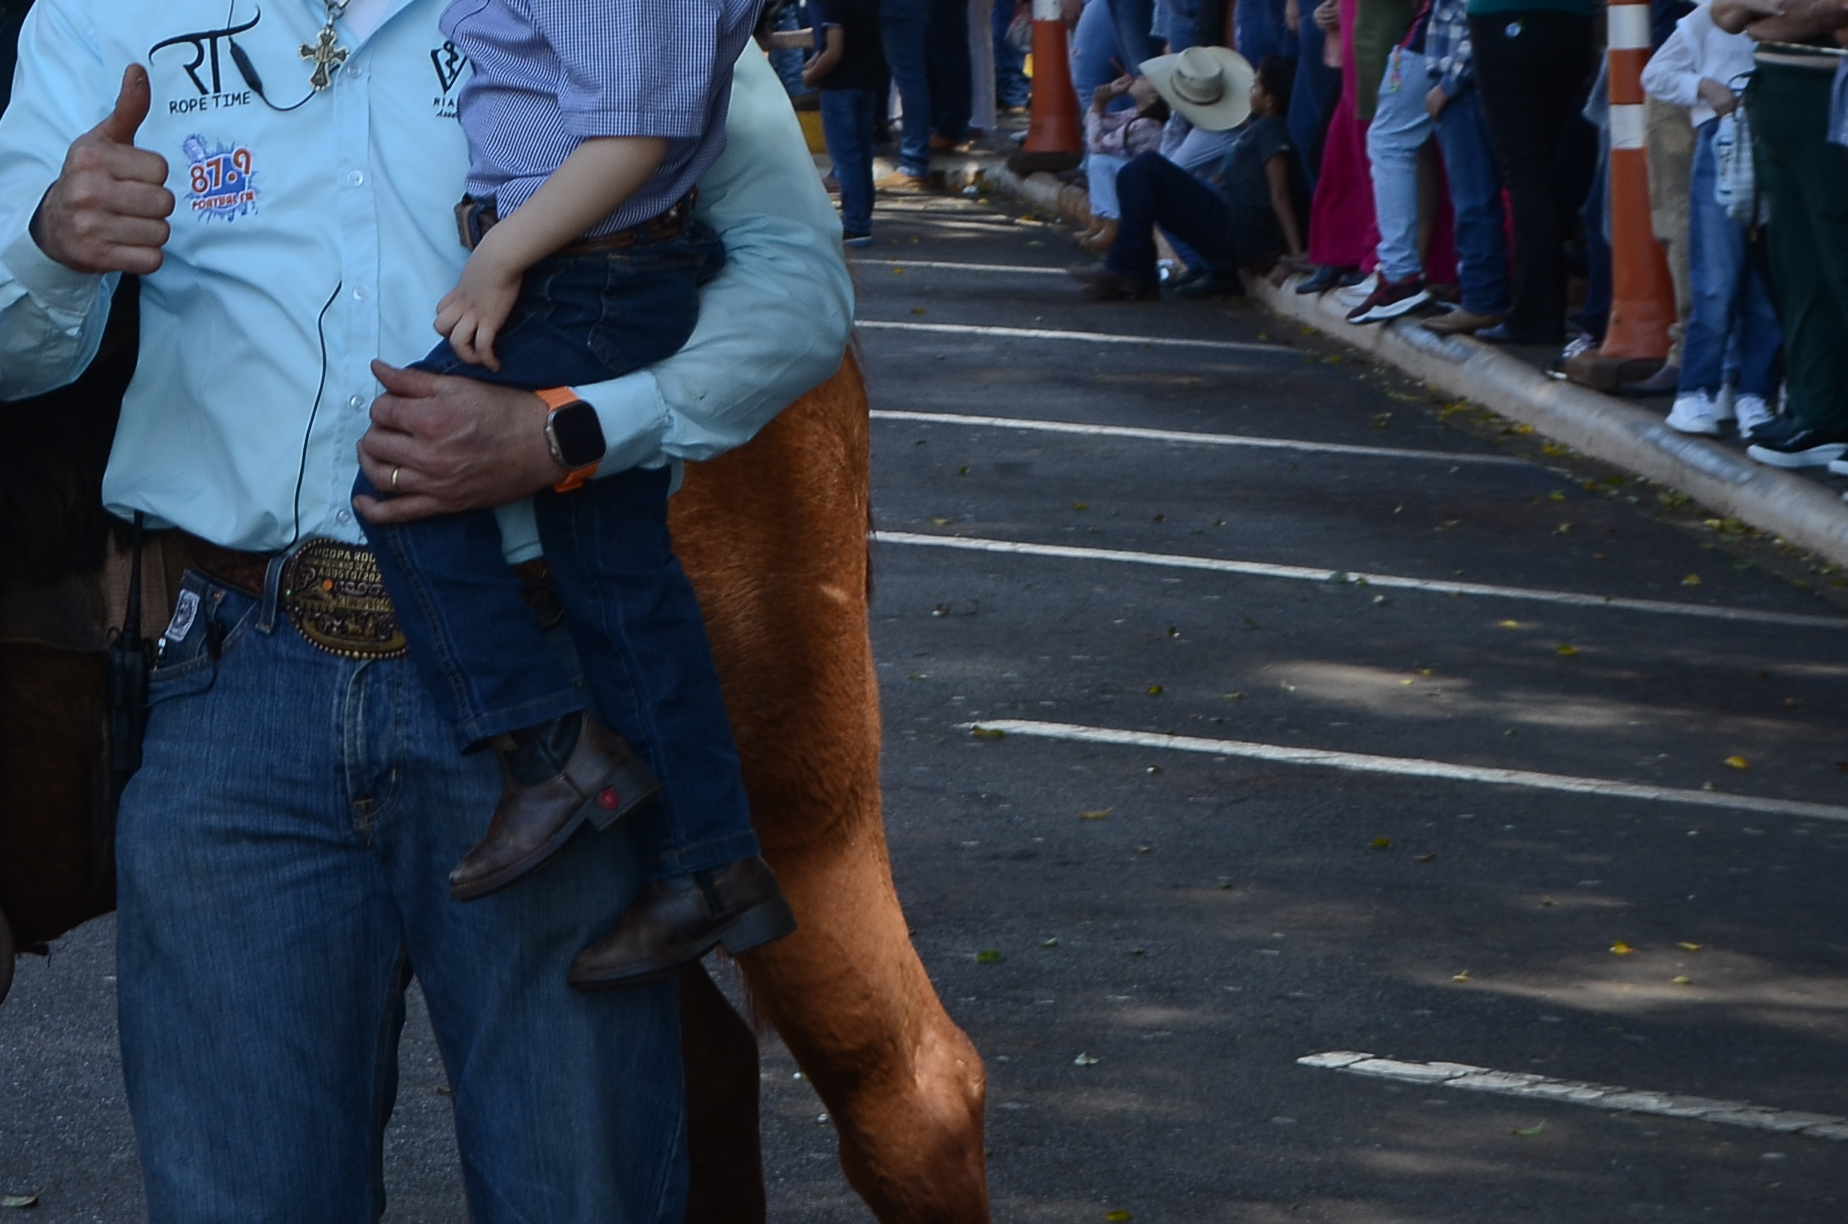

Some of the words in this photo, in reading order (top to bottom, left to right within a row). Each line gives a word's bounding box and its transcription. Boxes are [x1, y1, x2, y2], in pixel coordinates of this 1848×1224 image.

[168, 96, 209, 115] ROPE
[212, 90, 252, 108] TIME
[190, 147, 252, 194] 87.9
